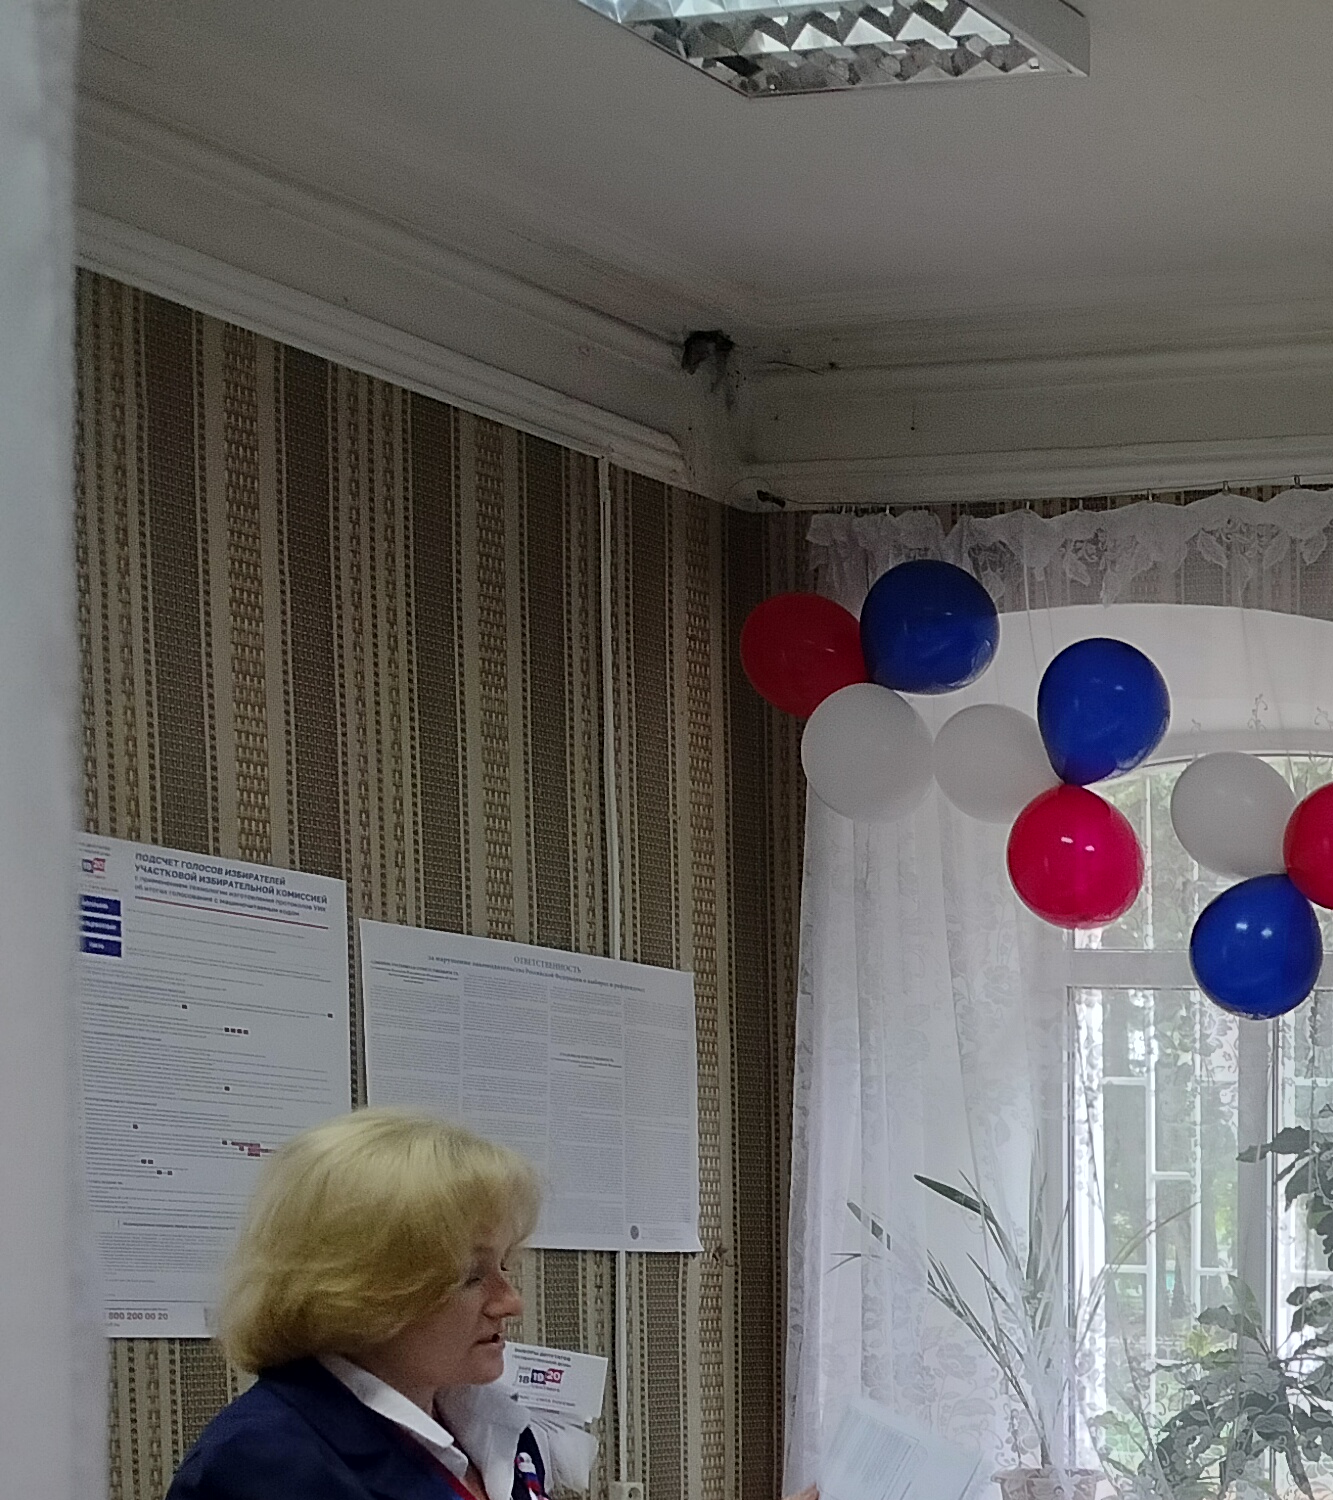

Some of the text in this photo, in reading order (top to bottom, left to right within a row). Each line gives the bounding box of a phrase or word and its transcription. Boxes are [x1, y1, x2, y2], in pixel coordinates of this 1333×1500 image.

[135, 853, 286, 886] ПОДСЧЕТ ГОЛОСОВ ИЗБИРАТЕЛЕЙ
[135, 865, 327, 904] УЧАСТКОВОЙ ИЗБИРАТЕЛЬНОЙ КОМИССИЕЙ
[126, 1312, 143, 1320] 200
[145, 1312, 156, 1320] 00
[158, 1312, 168, 1320] 20
